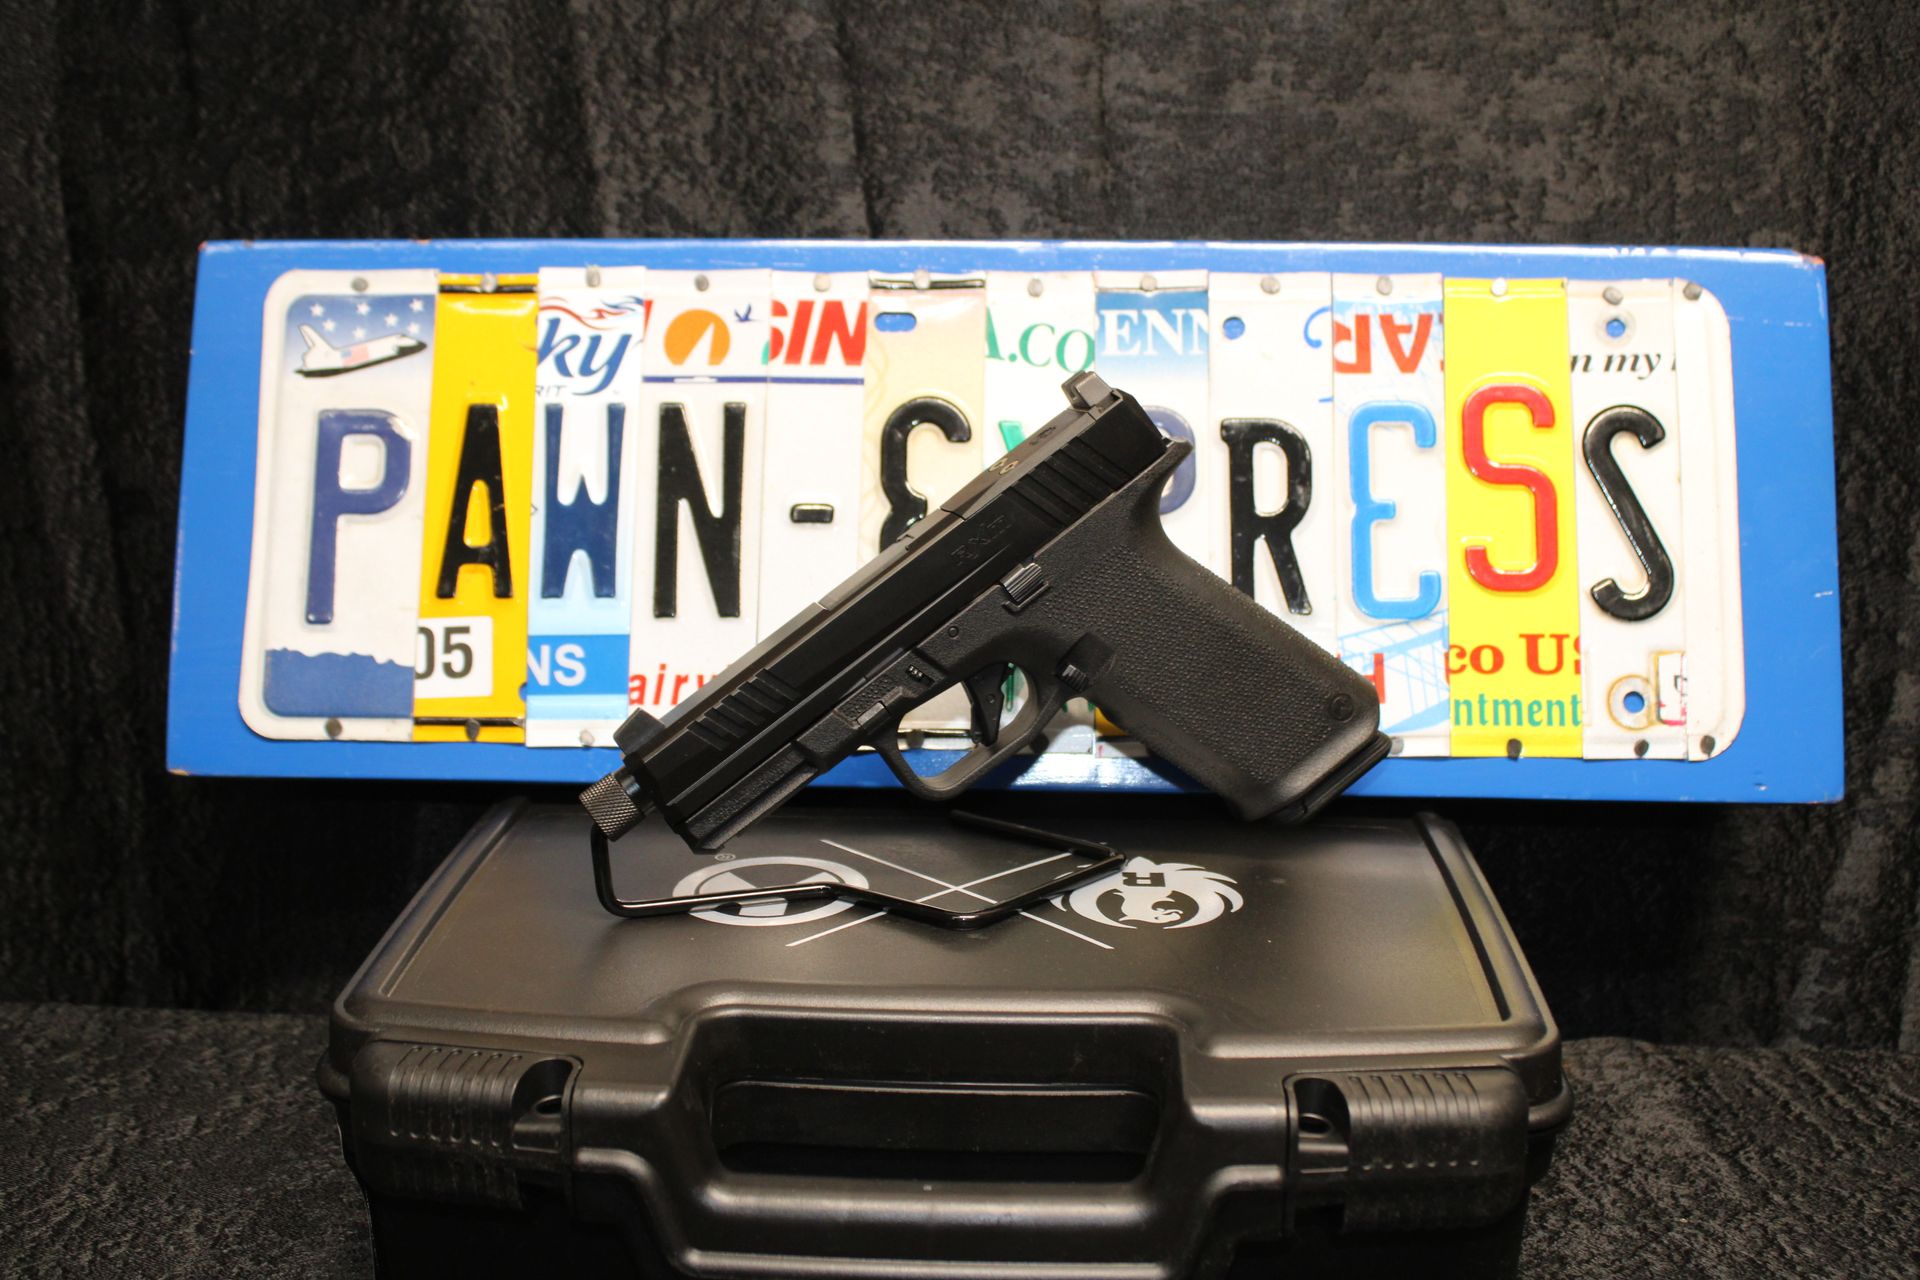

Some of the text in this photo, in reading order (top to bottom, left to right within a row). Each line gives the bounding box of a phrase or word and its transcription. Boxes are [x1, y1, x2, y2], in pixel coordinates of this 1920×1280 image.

[1096, 308, 1208, 356] EN
[1333, 313, 1444, 374] AR
[1603, 352, 1661, 381] my
[1454, 693, 1582, 727] ntment
